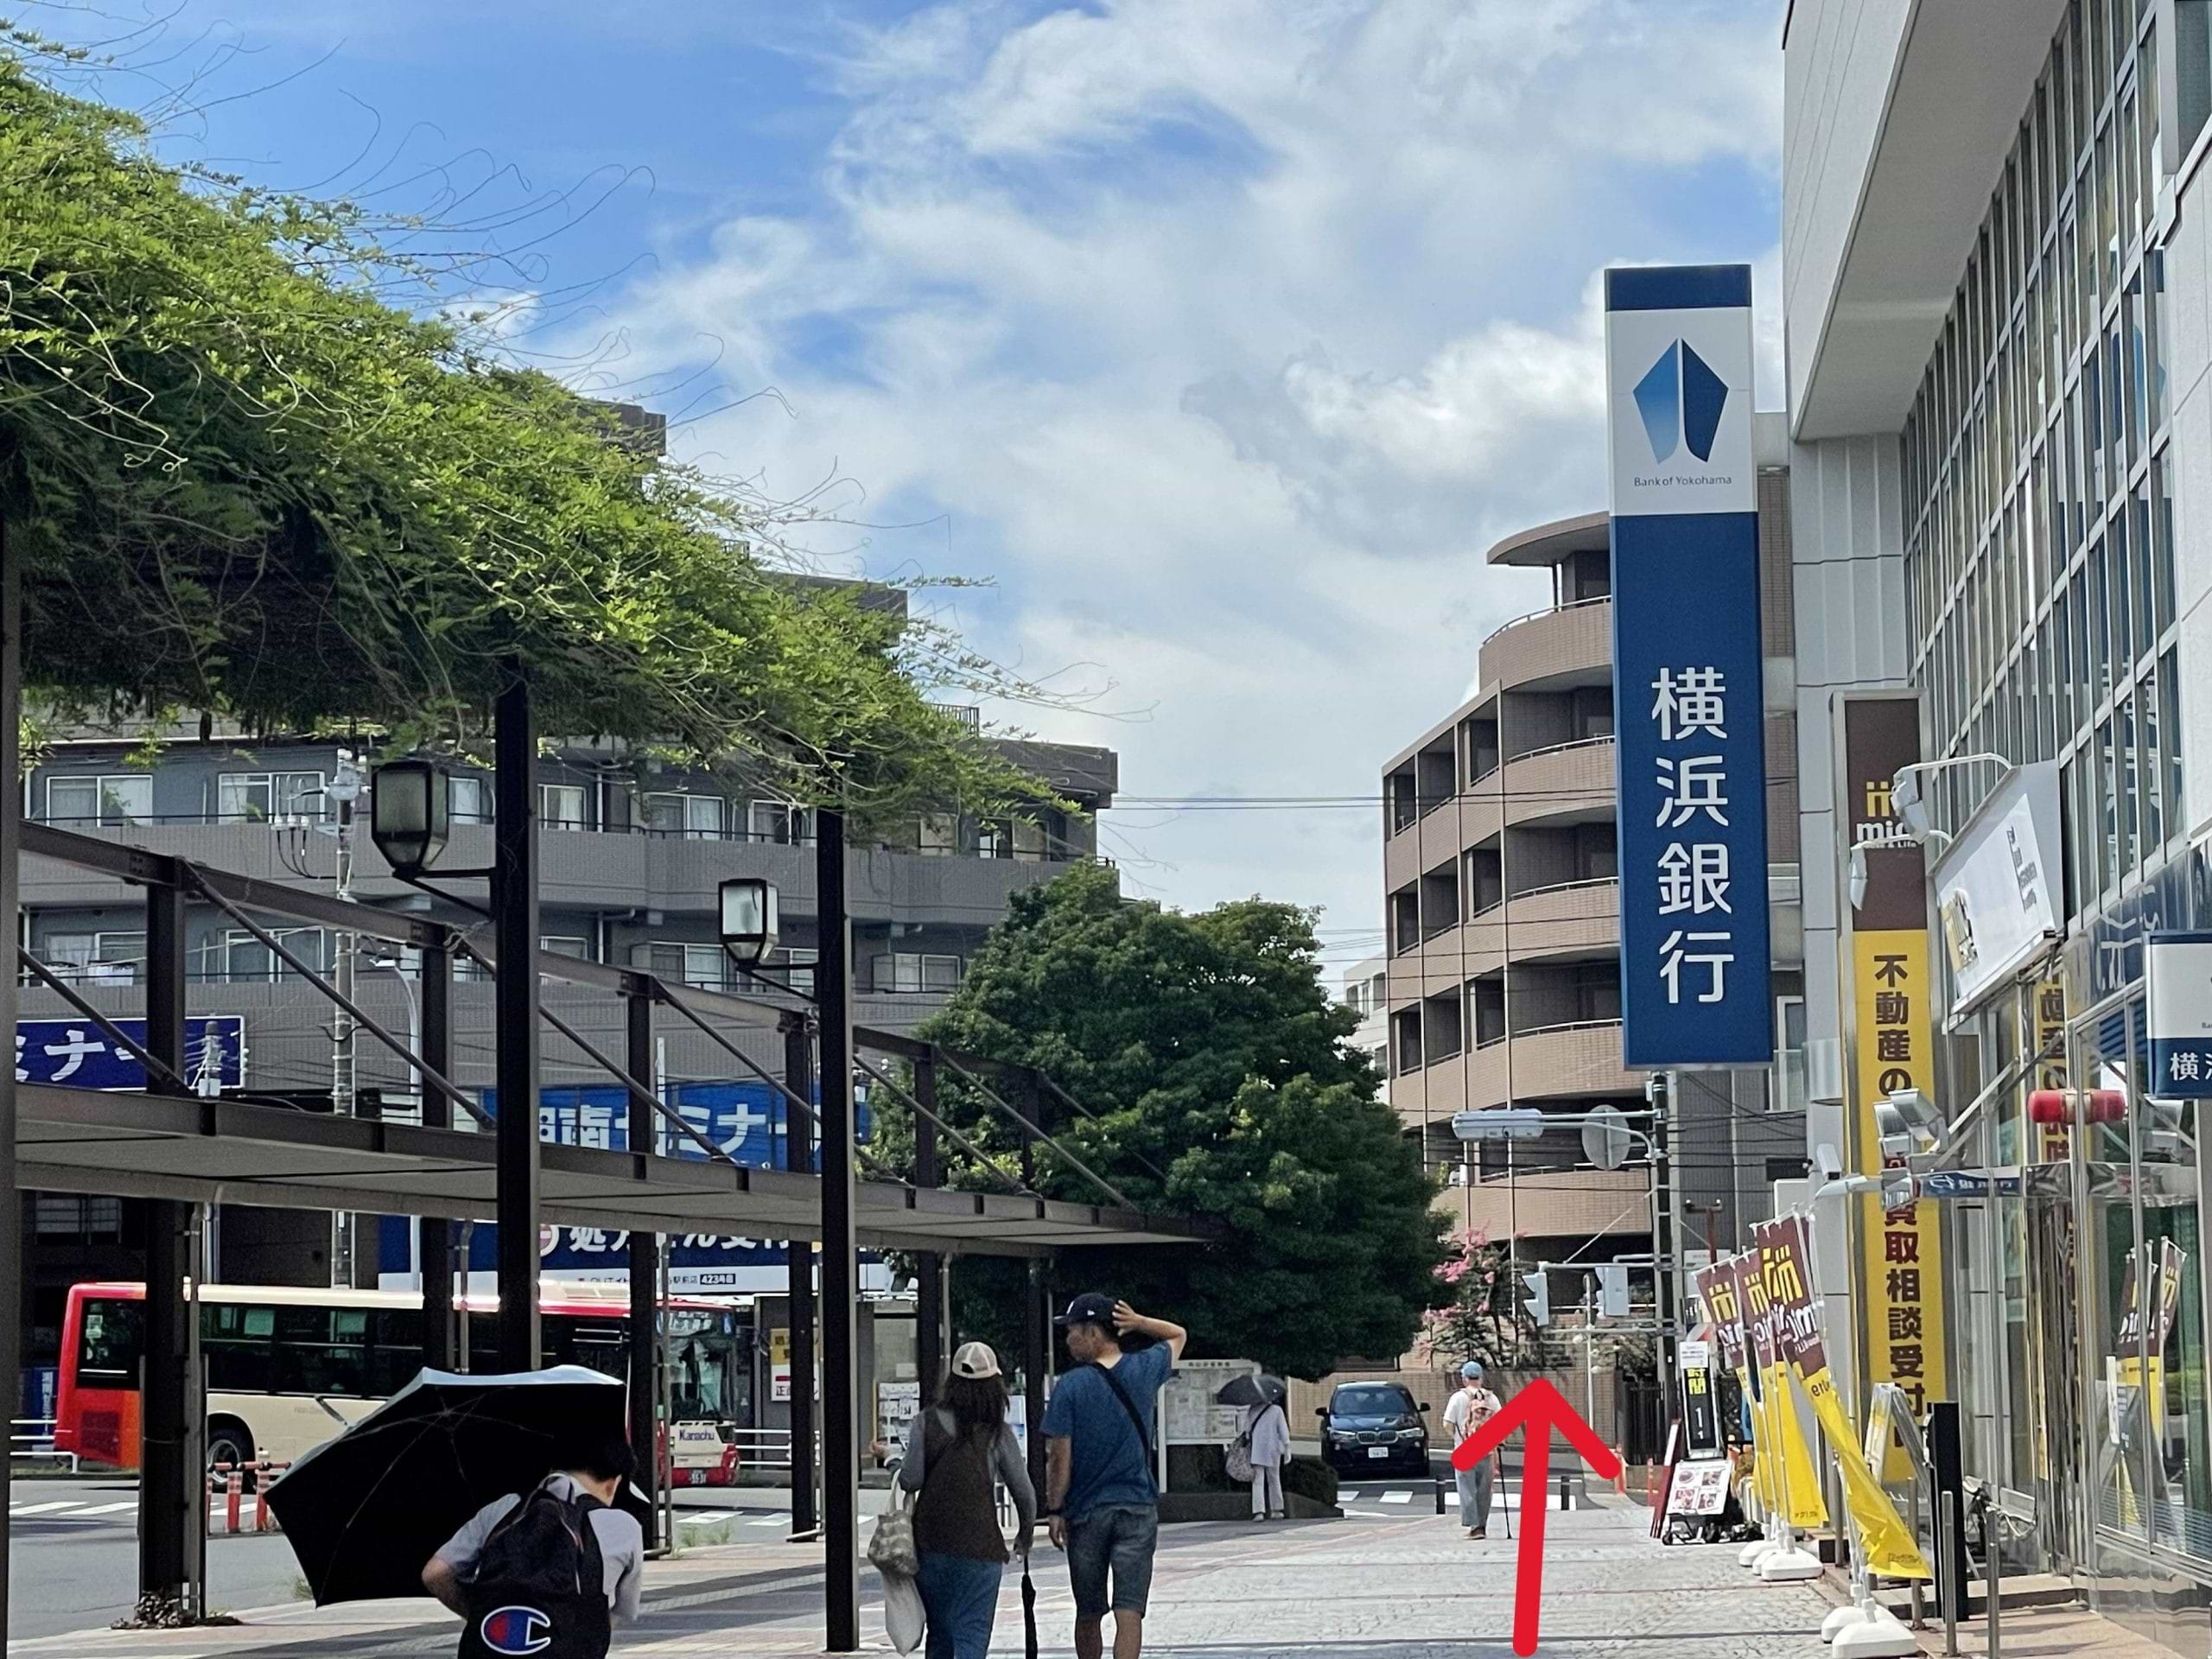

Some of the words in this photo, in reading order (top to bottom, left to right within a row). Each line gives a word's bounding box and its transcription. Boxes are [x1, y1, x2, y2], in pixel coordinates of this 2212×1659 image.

[1634, 476, 1660, 486] Bank
[1662, 476, 1673, 486] of
[1675, 475, 1732, 486] Yokohama
[1650, 666, 1735, 1004] 横浜銀行
[678, 1429, 715, 1441] Kanachu
